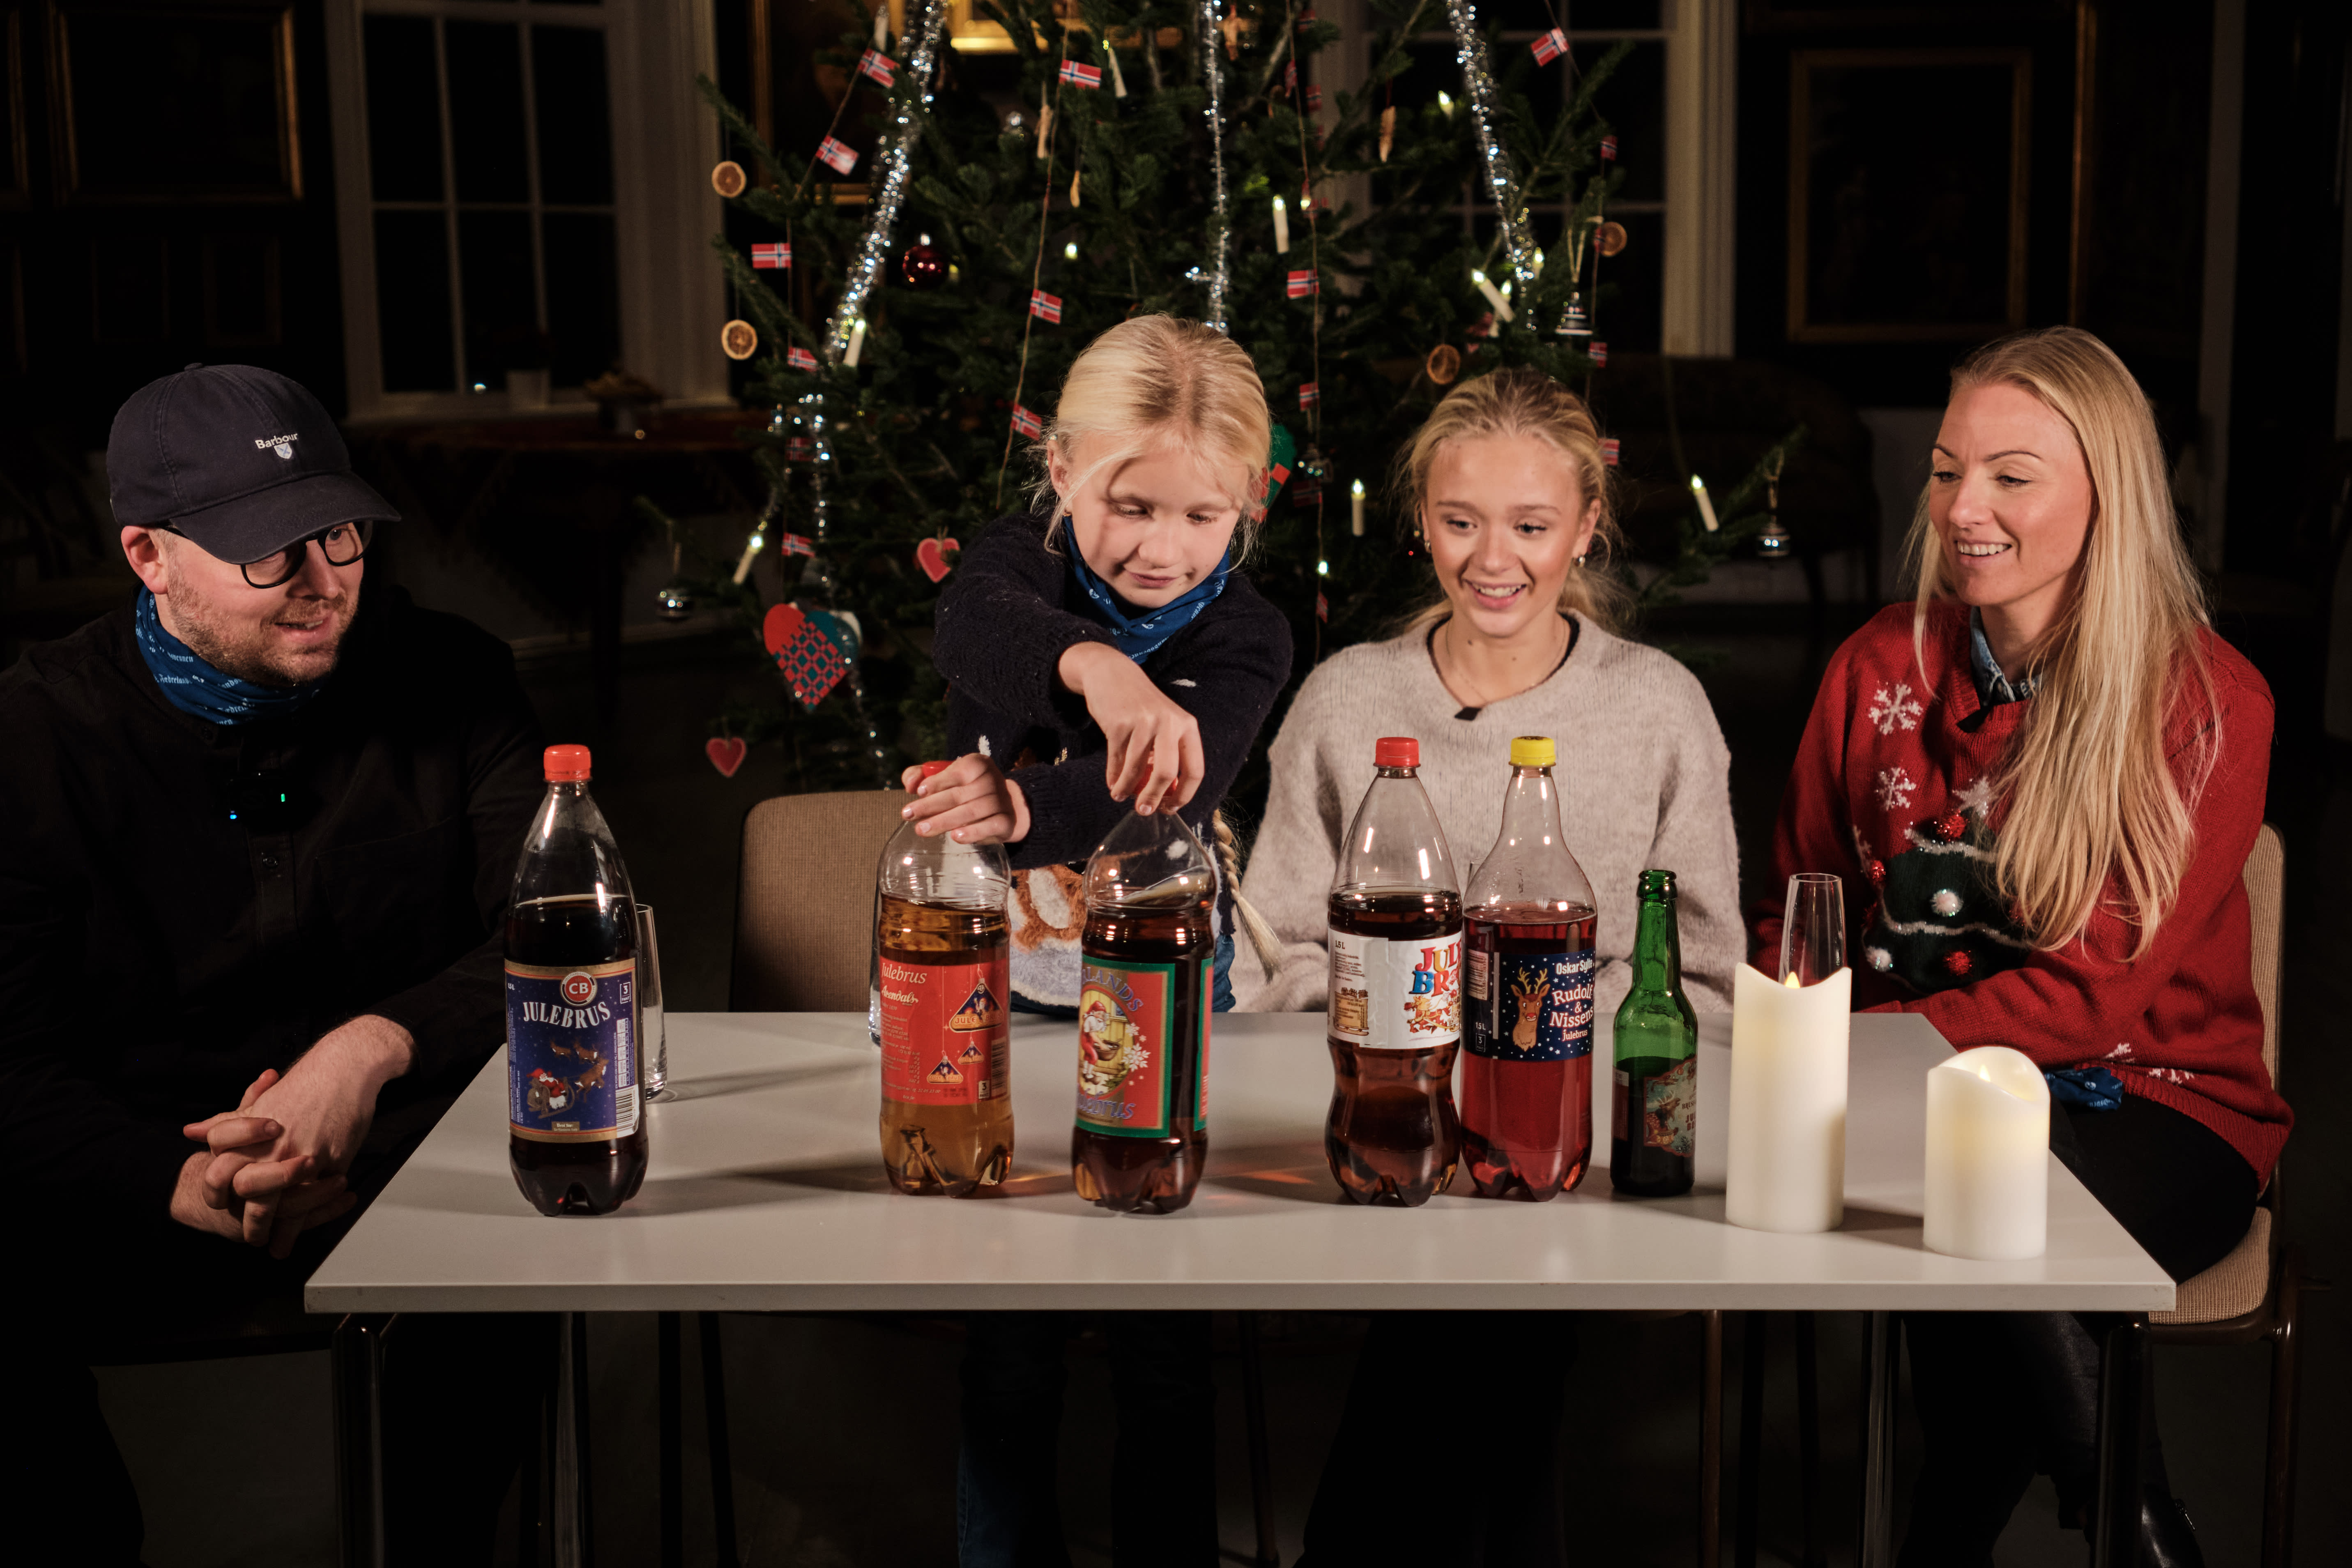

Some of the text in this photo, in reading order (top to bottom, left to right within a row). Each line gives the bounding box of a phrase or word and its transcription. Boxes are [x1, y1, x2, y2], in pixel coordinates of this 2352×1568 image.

[255, 433, 298, 449] Barbour
[881, 962, 927, 984] Julebrus
[1556, 958, 1593, 975] Oskar Sylte
[569, 982, 589, 994] CB
[623, 985, 628, 995] 3
[1409, 969, 1459, 997] BR
[1552, 983, 1593, 1006] Rudolf
[523, 1001, 611, 1029] JULEBRUS
[1574, 1001, 1582, 1013] &
[1549, 1006, 1593, 1027] Nissens
[982, 1082, 987, 1091] 3
